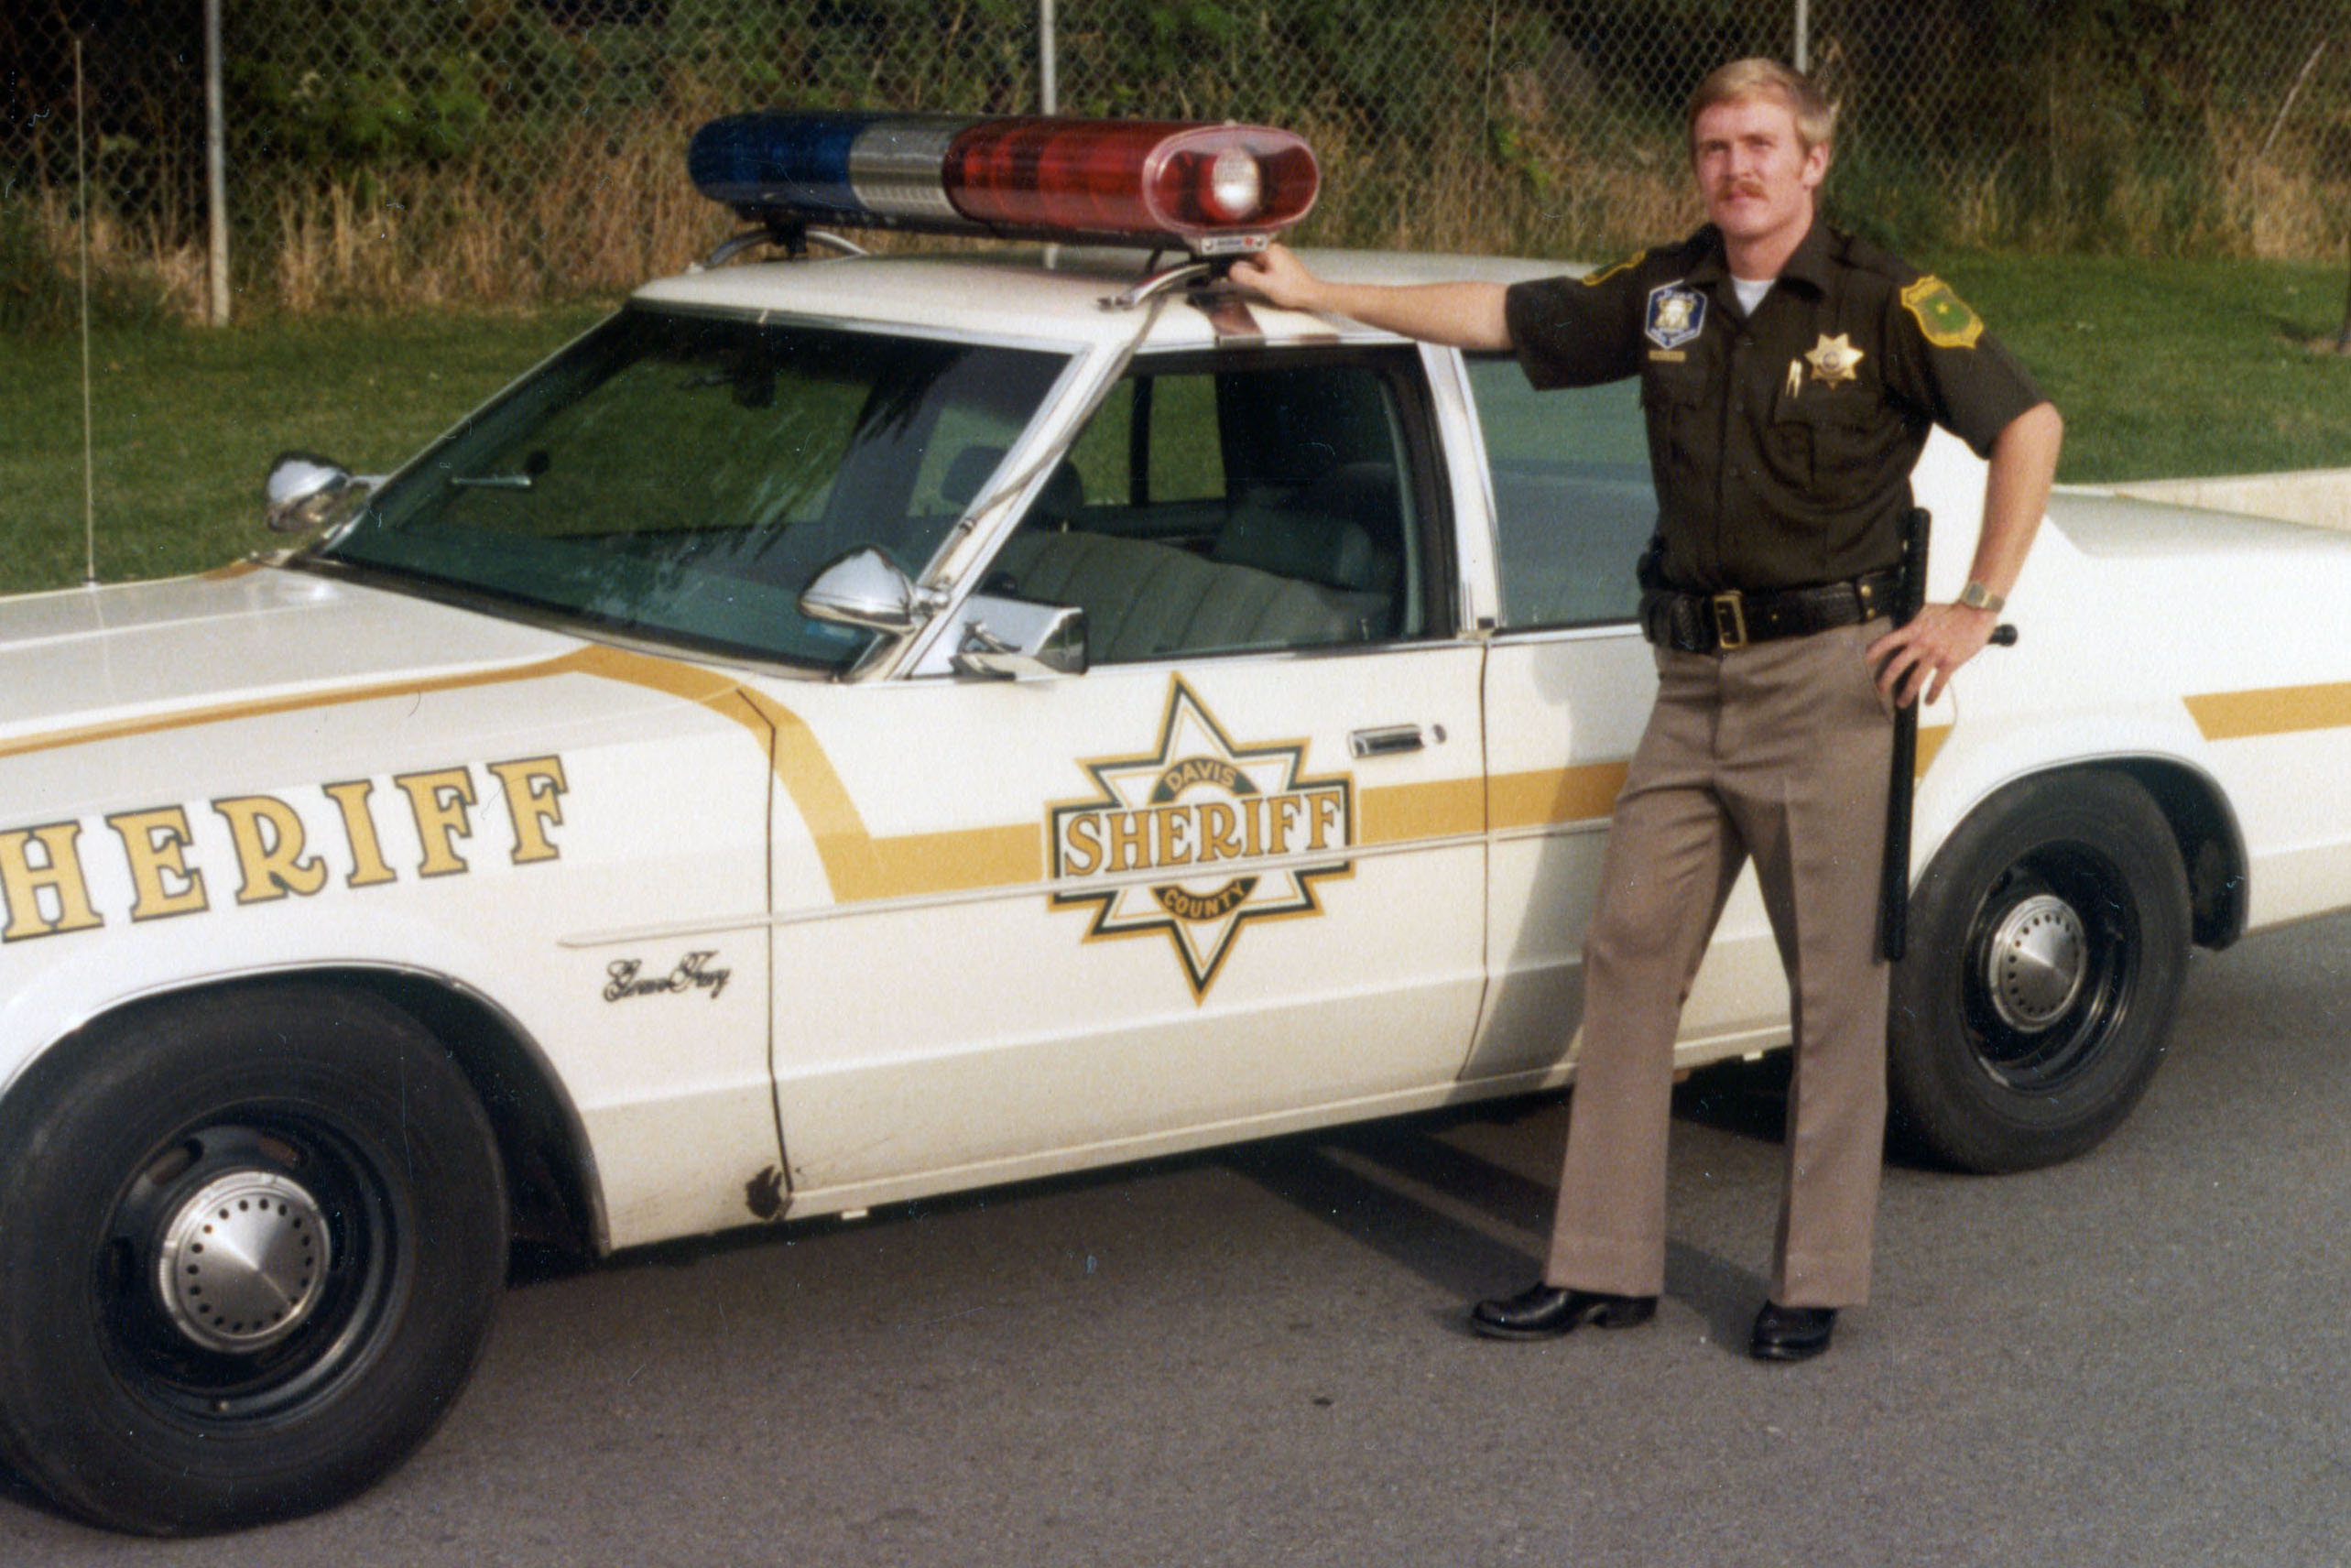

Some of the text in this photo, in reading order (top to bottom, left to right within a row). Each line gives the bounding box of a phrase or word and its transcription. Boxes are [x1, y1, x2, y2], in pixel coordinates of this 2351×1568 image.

[1164, 760, 1236, 792] DAVIS
[1064, 790, 1342, 877] SHERIFF
[1164, 880, 1246, 918] COUNTY
